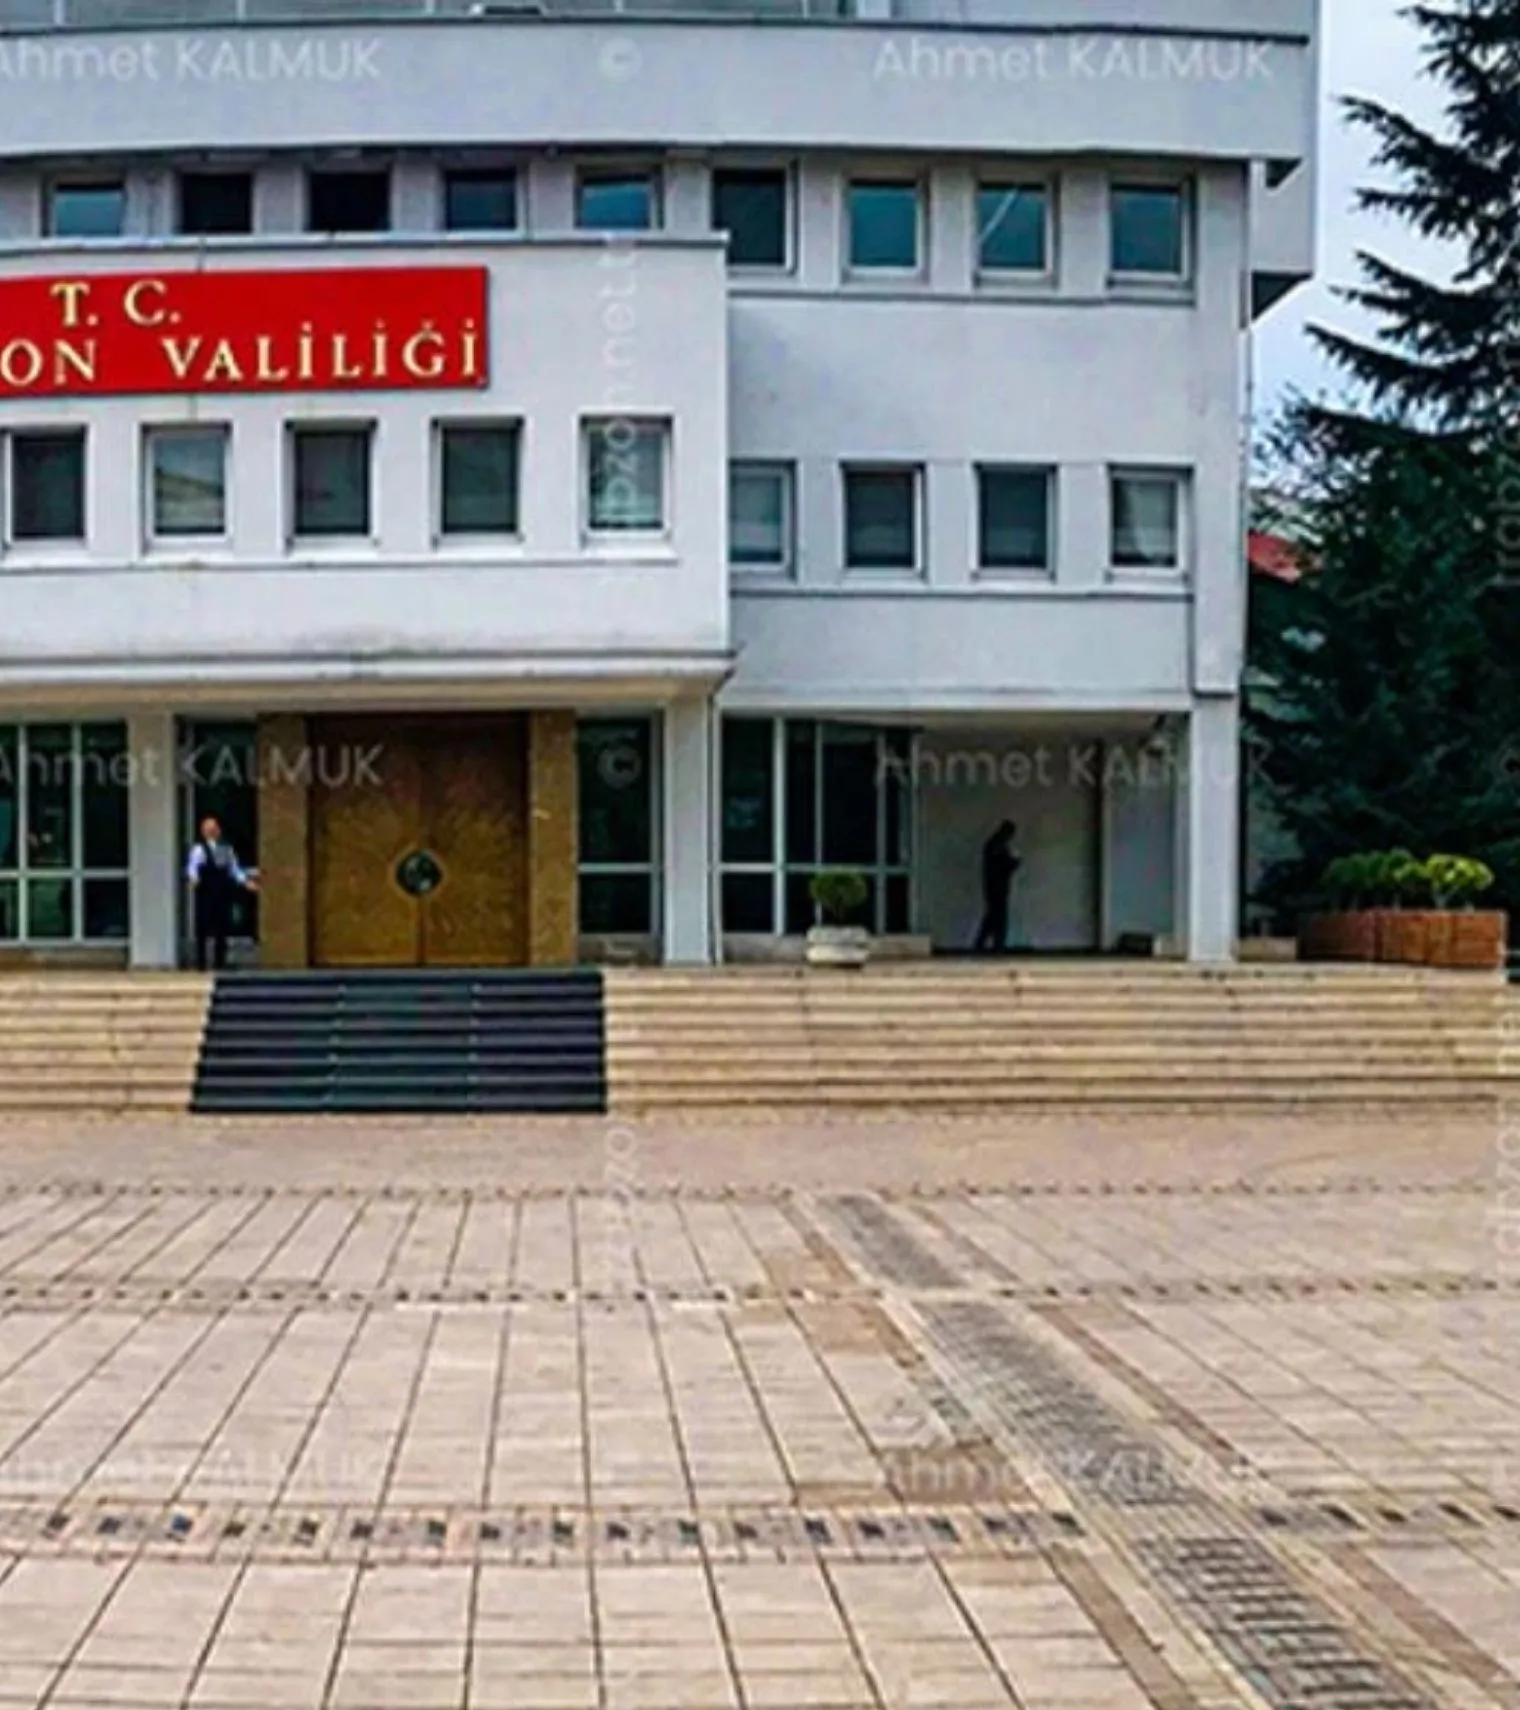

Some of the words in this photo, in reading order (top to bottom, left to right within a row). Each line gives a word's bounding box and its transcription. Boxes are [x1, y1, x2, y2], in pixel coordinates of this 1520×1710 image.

[51, 282, 98, 326] T.
[123, 279, 181, 324] C.
[161, 318, 477, 381] VALİLİĞİ
